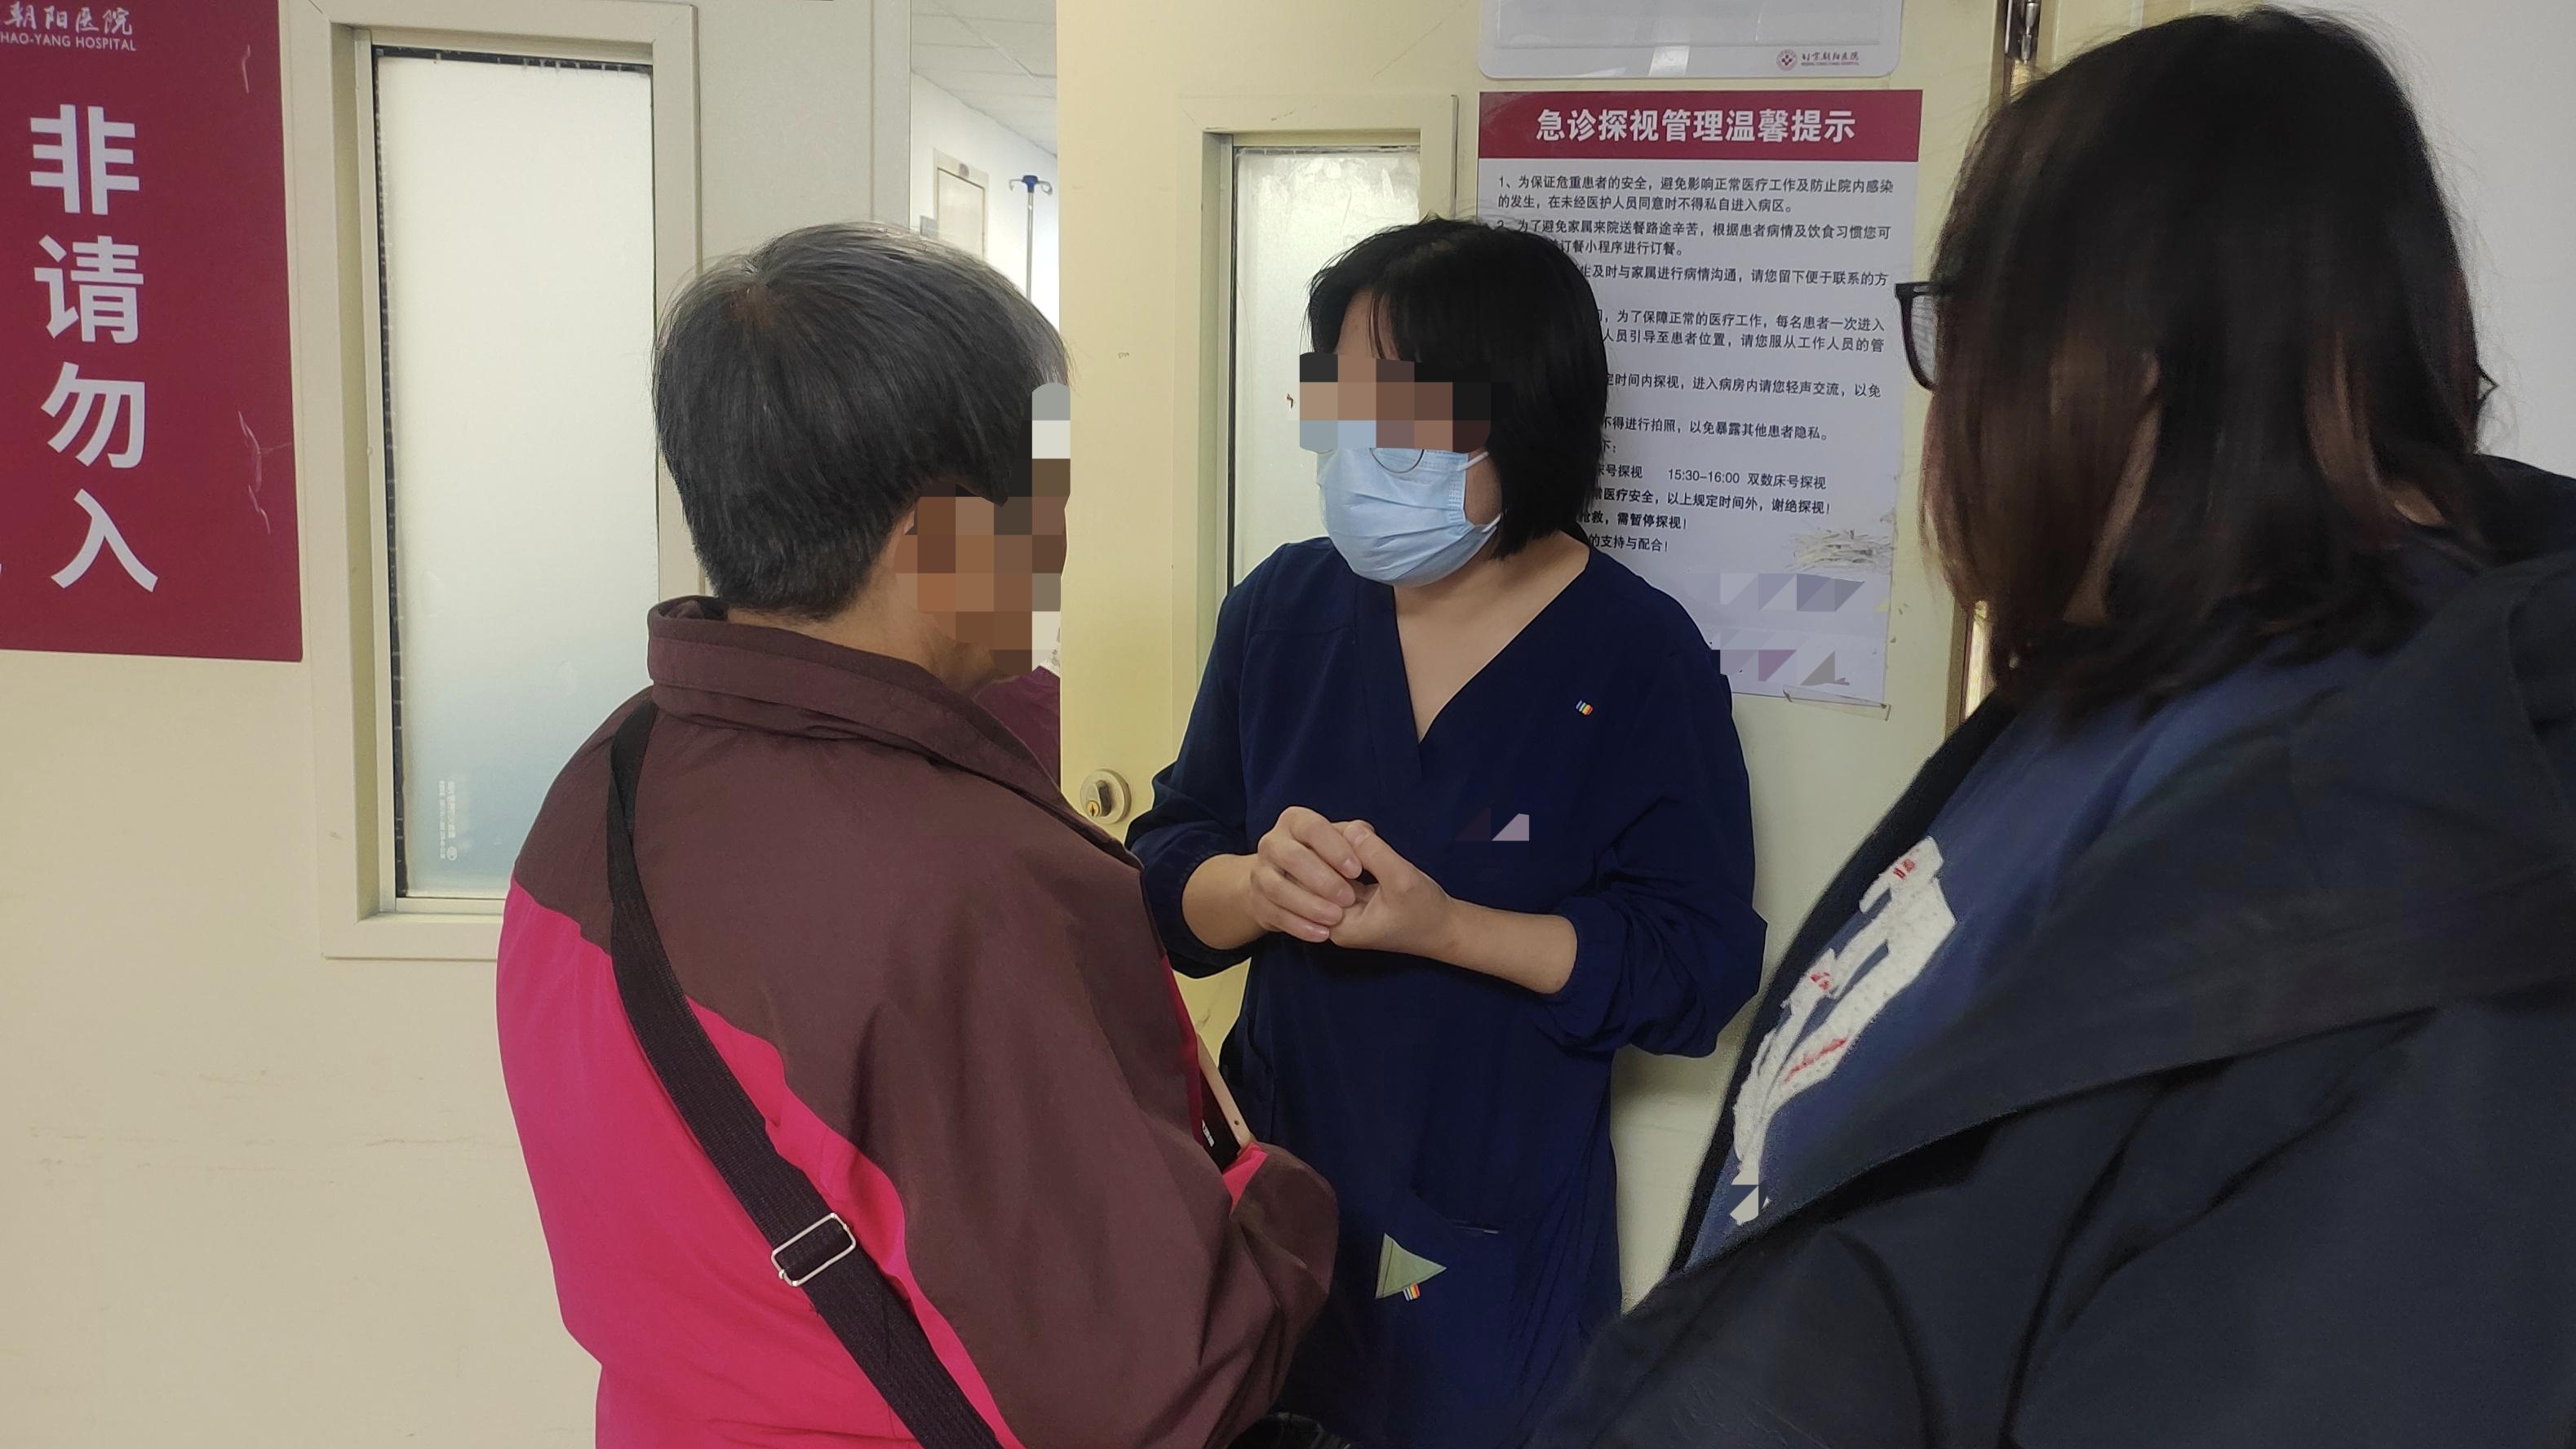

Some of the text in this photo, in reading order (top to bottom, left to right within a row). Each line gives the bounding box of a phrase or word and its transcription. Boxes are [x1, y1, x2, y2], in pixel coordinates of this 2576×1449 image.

[76, 37, 136, 51] HOSPITAL
[1536, 109, 1856, 143] 急诊探视管理温馨提示
[1498, 195, 1793, 213] 的发生，在未经医护人员同意时不得私自进入病区。
[1496, 219, 1891, 239] 2为了避免家属来院送餐路途辛苦，根据患者病情及饮食习惯您可
[1553, 238, 1683, 256] 订餐小程序进行订餐。
[30, 104, 158, 592] 非请勿入
[1669, 468, 1740, 484] 15:30-16:00
[1747, 472, 1827, 490] 双数床号探视
